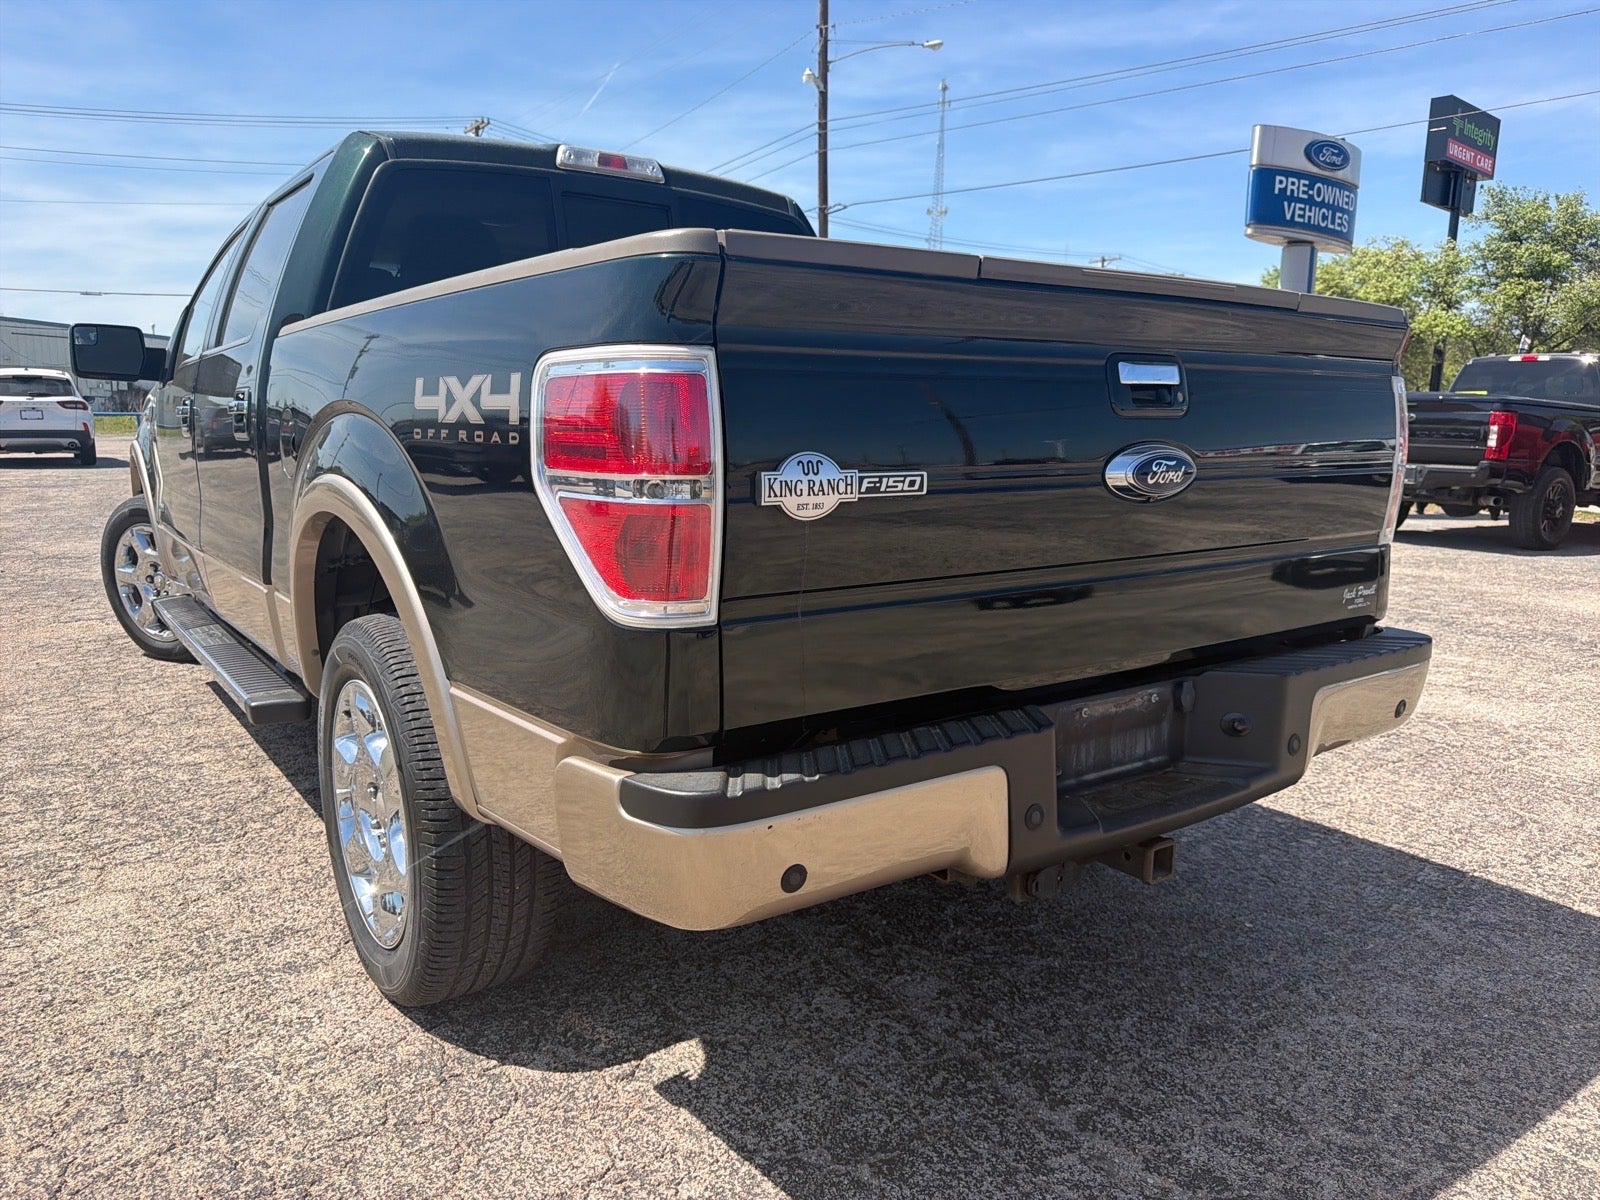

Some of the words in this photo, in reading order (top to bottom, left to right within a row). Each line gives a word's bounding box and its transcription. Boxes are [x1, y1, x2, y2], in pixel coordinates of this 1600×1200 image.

[1464, 118, 1496, 151] Integrity
[1319, 146, 1344, 165] Ford
[1450, 142, 1475, 164] URGENT
[1476, 155, 1493, 172] CARE
[1274, 175, 1356, 212] PRE-OWNED
[1283, 201, 1349, 233] VEHICLES
[414, 372, 521, 425] 4X4
[413, 428, 449, 440] OFF
[458, 429, 520, 445] ROAD
[1147, 459, 1185, 485] Ford
[767, 477, 803, 498] KING
[807, 475, 854, 497] RANCH
[796, 503, 810, 511] EST.
[812, 502, 825, 510] 1853
